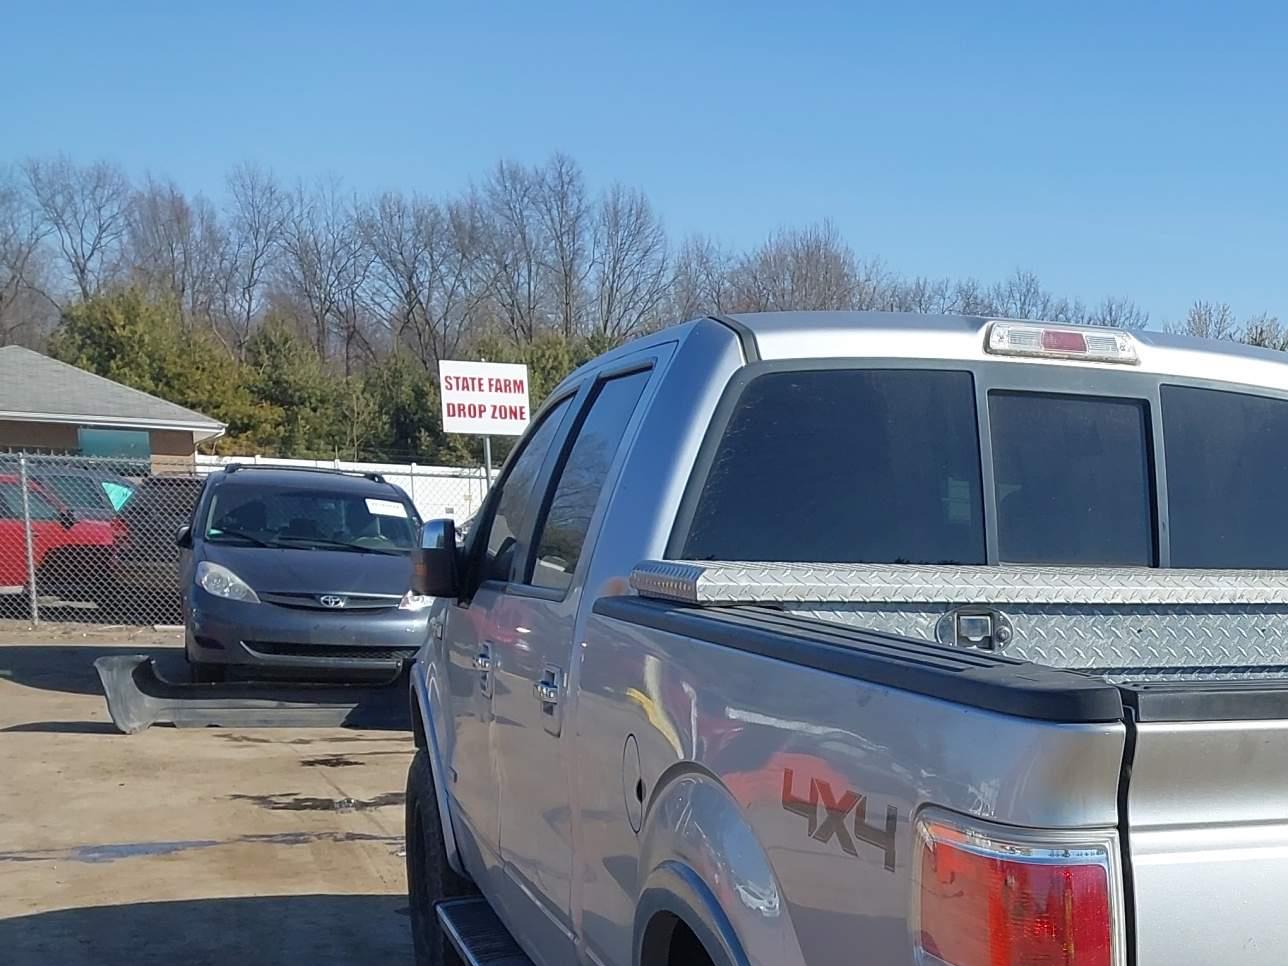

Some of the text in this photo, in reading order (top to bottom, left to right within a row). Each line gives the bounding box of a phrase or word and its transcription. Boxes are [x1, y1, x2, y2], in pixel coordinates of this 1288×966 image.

[444, 375, 524, 394] STATE FARM
[446, 402, 526, 421] DROP ZONE
